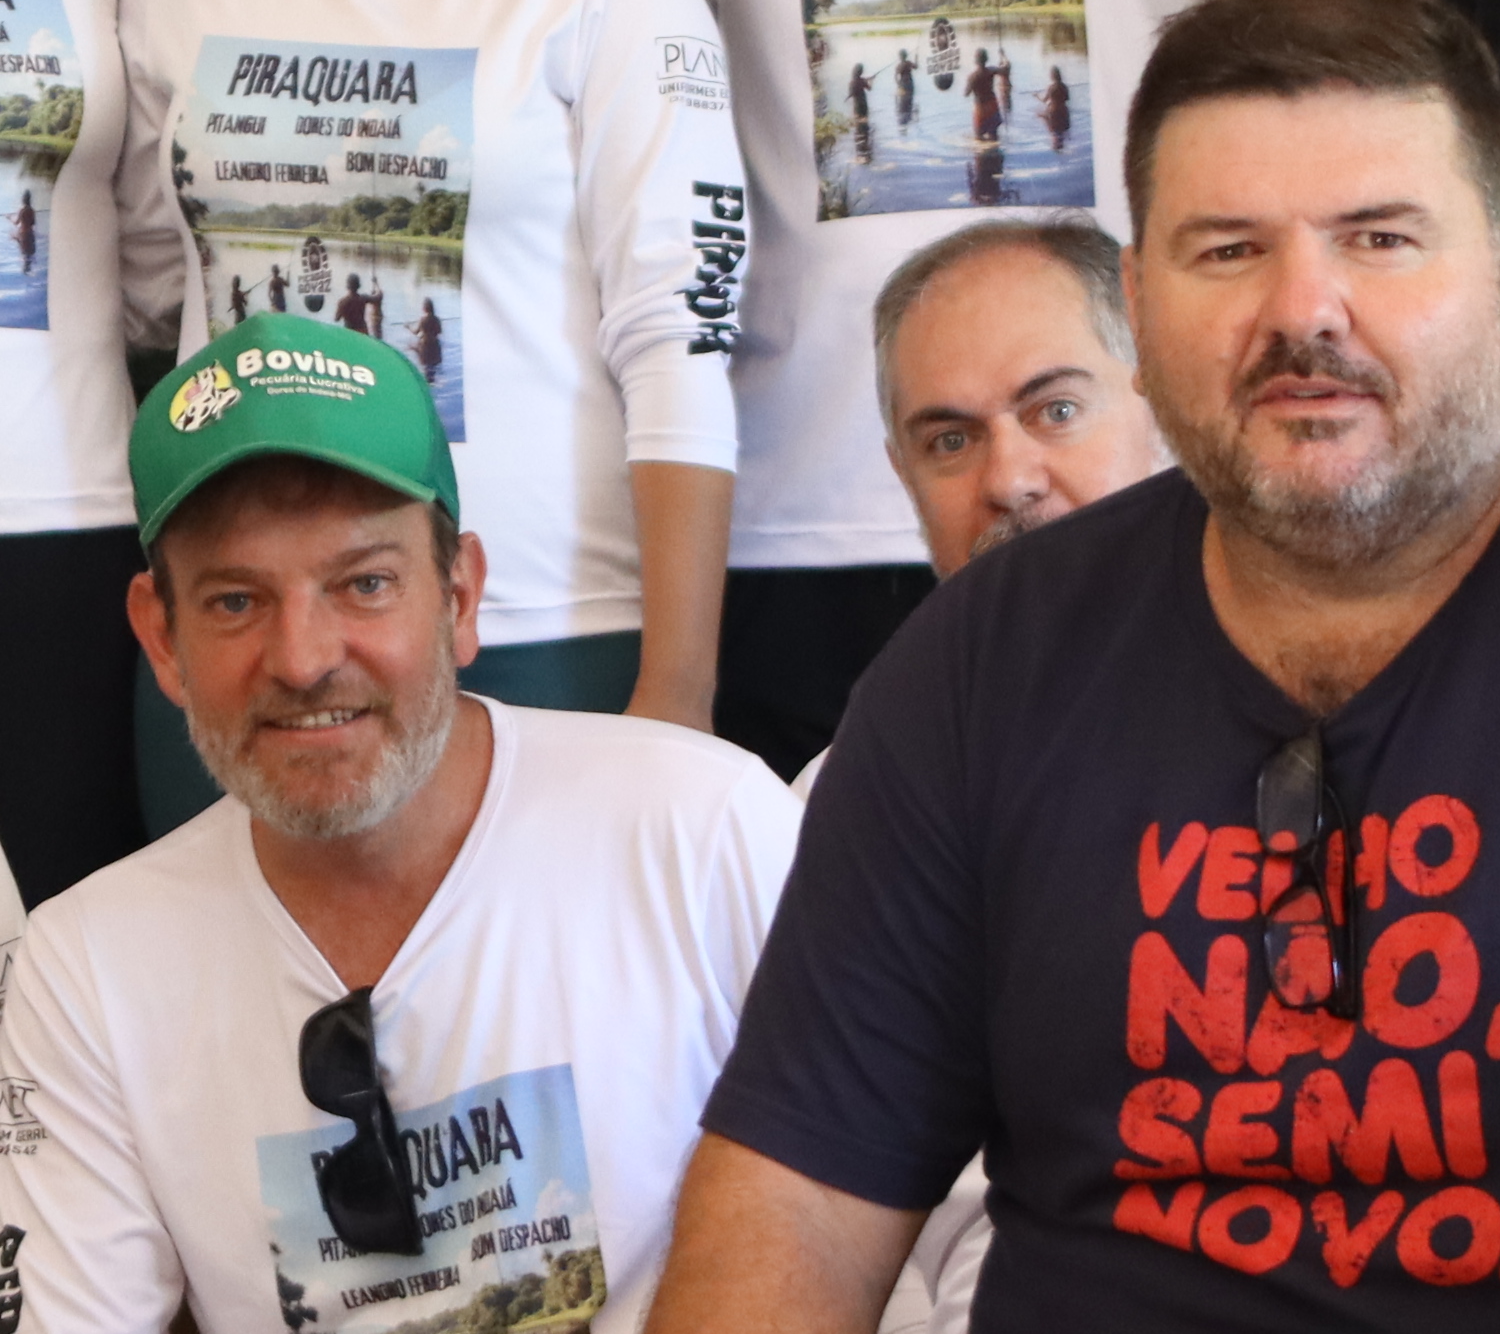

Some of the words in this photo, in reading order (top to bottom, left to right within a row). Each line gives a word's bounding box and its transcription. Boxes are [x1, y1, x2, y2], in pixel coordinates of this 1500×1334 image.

[227, 53, 418, 107] PIRAQUARA
[205, 112, 268, 135] PITANGUI
[294, 113, 333, 136] DORES
[336, 116, 354, 137] DO
[215, 160, 271, 182] LEANDRO
[275, 162, 329, 185] FERREIRA
[345, 150, 375, 172] BOM
[378, 153, 447, 180] DESPACHO
[236, 347, 376, 387] Bovina
[250, 373, 307, 388] Pecuária
[308, 375, 366, 396] Lucrativa
[1112, 1049, 1488, 1185] SEMI
[459, 1198, 476, 1226] DO
[340, 1279, 406, 1311] LEANDRO
[471, 1232, 496, 1262] BOM
[499, 1215, 571, 1253] DESPACHO
